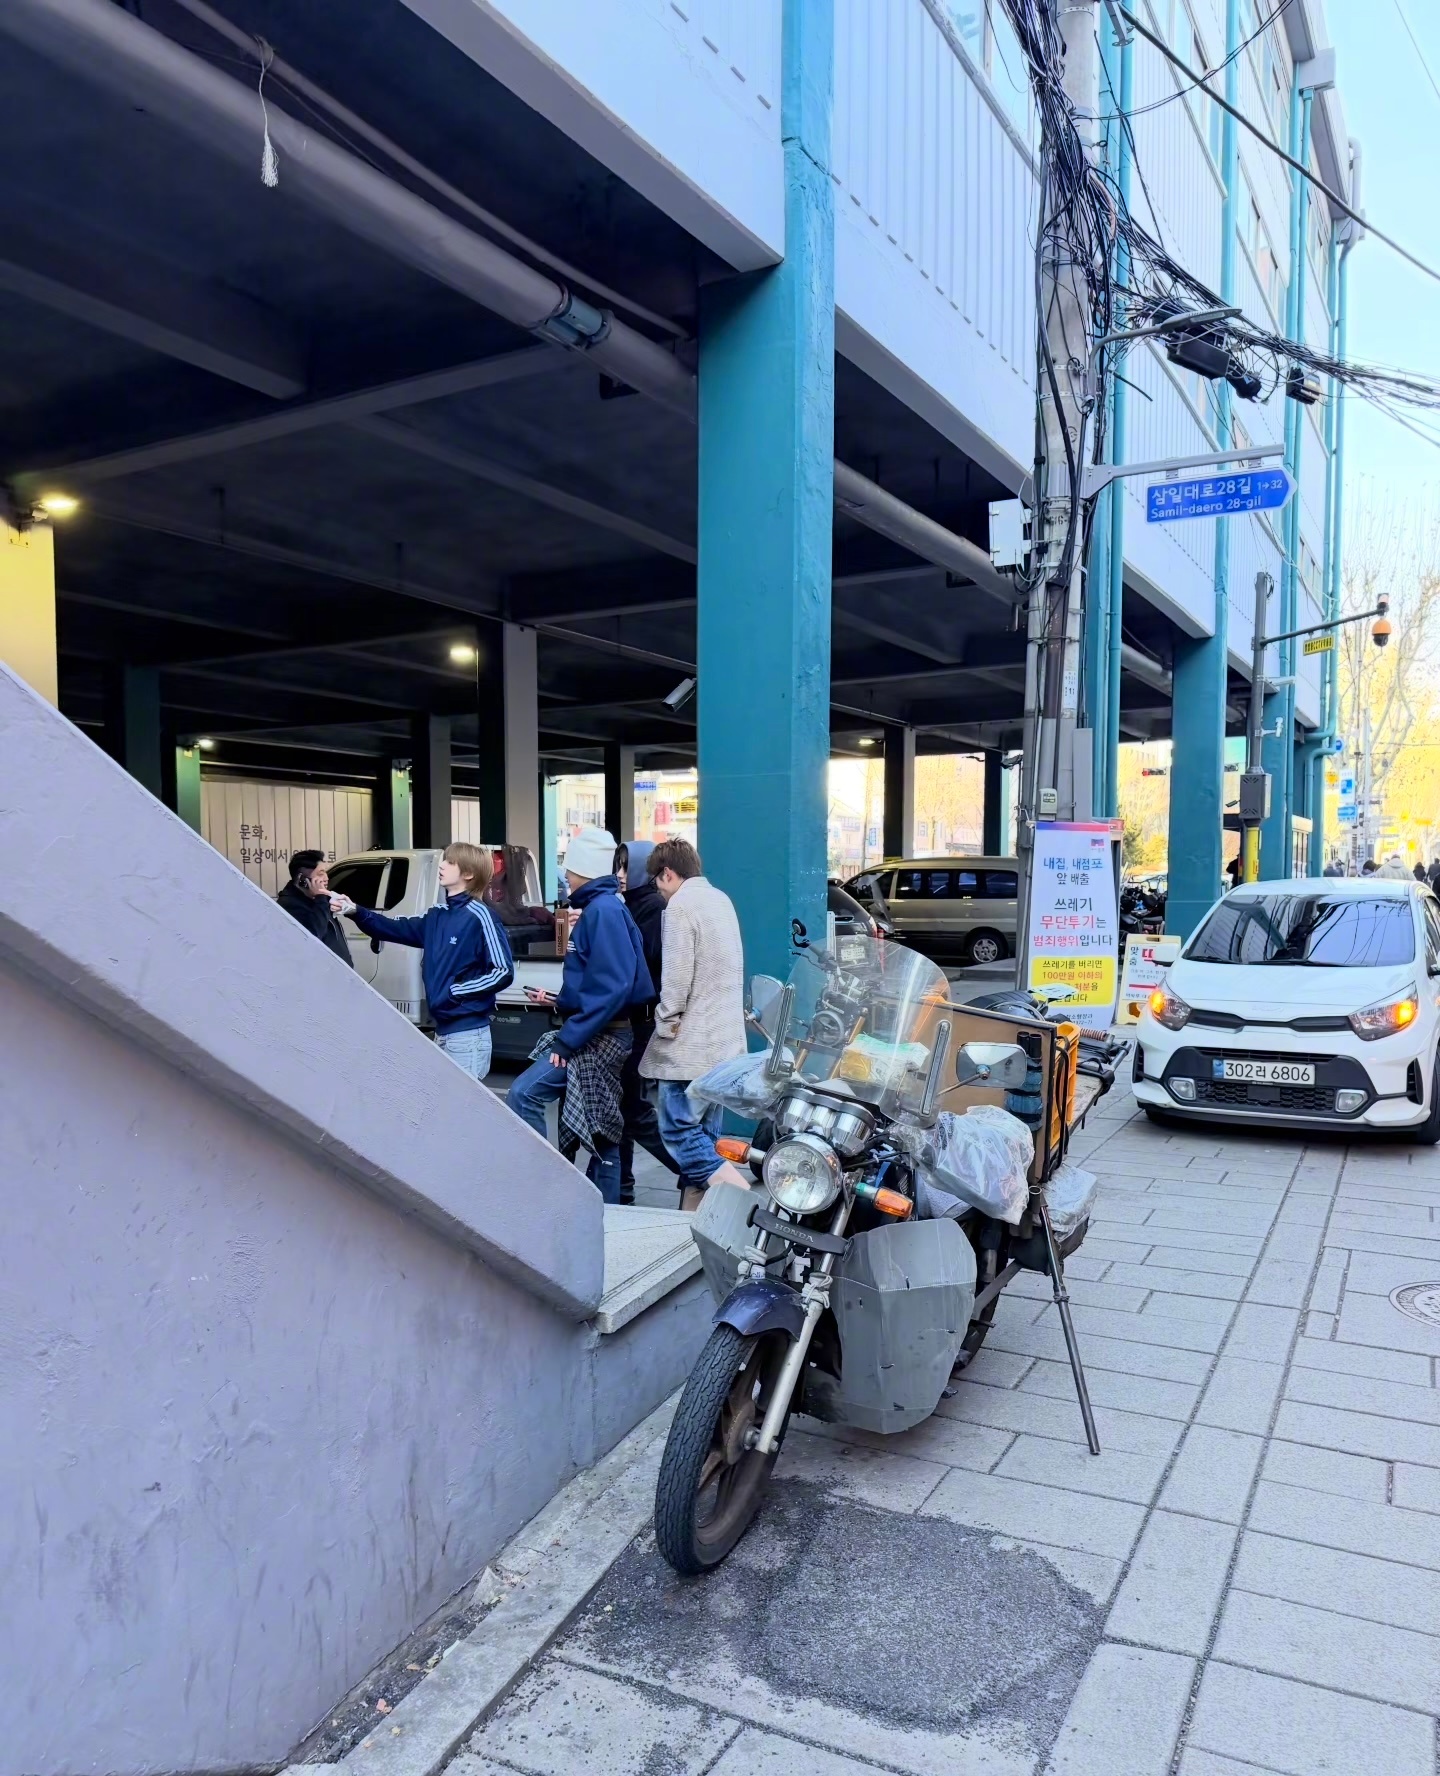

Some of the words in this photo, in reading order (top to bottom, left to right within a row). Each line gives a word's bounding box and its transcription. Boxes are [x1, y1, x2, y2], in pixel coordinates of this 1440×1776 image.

[1152, 477, 1251, 505] 삼일대로28길
[1151, 501, 1223, 519] Samil-daero
[1226, 495, 1261, 511] 28-gil
[239, 824, 268, 841] 문화,
[240, 847, 288, 864] 일상에서
[1072, 857, 1103, 870] 내점포
[1056, 872, 1067, 885] 앞
[1070, 872, 1090, 886] 배출
[1054, 897, 1092, 912] 쓰레기
[1040, 914, 1107, 929] 무단투기는
[1033, 934, 1113, 947] 범죄행위입니다
[1042, 960, 1076, 969] 쓰레기를
[1078, 959, 1103, 969] 버리면
[1043, 971, 1075, 981] 100만원
[1078, 971, 1103, 980] 이하의
[1225, 1062, 1266, 1079] 302러
[1270, 1065, 1310, 1082] 6806
[774, 1222, 814, 1243] HONDA
